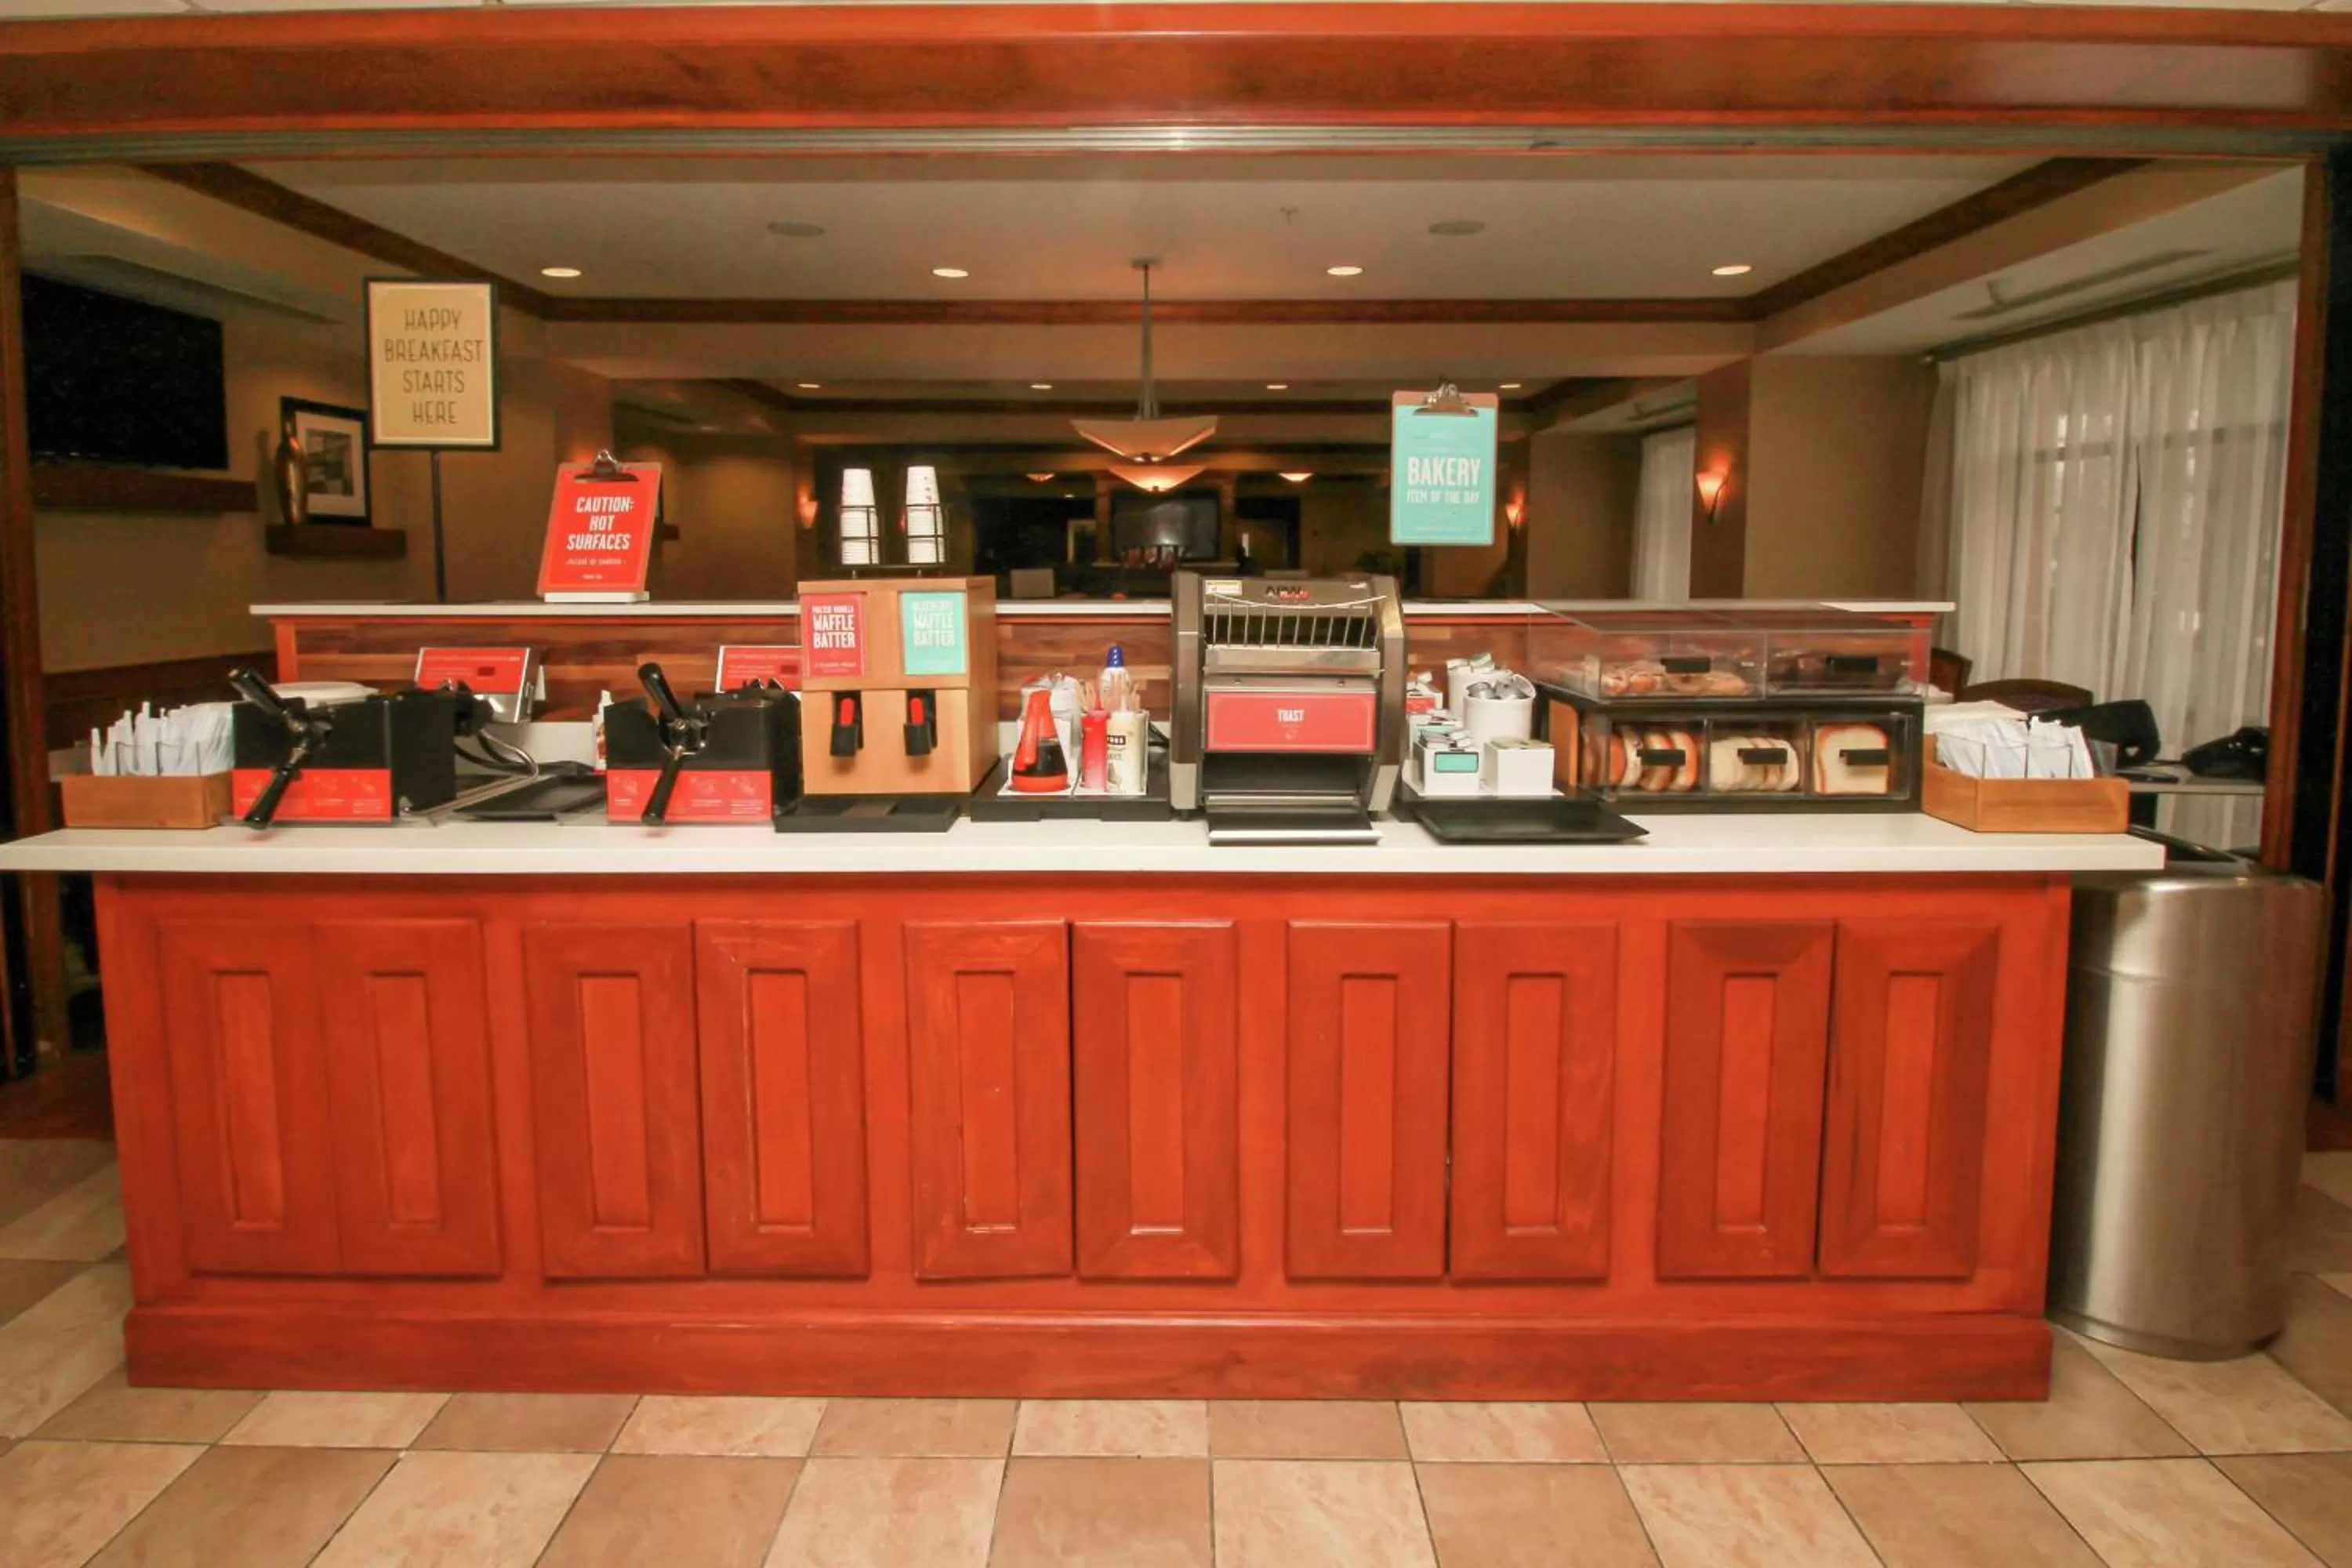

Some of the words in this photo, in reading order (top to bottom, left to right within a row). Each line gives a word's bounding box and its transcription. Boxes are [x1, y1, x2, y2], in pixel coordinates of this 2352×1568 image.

[404, 307, 462, 331] HAPPY
[384, 338, 483, 362] BREAKFAST
[402, 369, 465, 394] STARTS
[412, 401, 459, 424] HERE
[1406, 456, 1481, 486] BAKERY
[589, 515, 615, 532] HOT
[566, 533, 632, 551] SURFACES
[813, 614, 855, 630] WAFFLE
[913, 612, 954, 630] WAFFLE
[813, 631, 855, 648] BATTER
[913, 630, 955, 648] BATTER
[1279, 709, 1305, 722] TOAST
